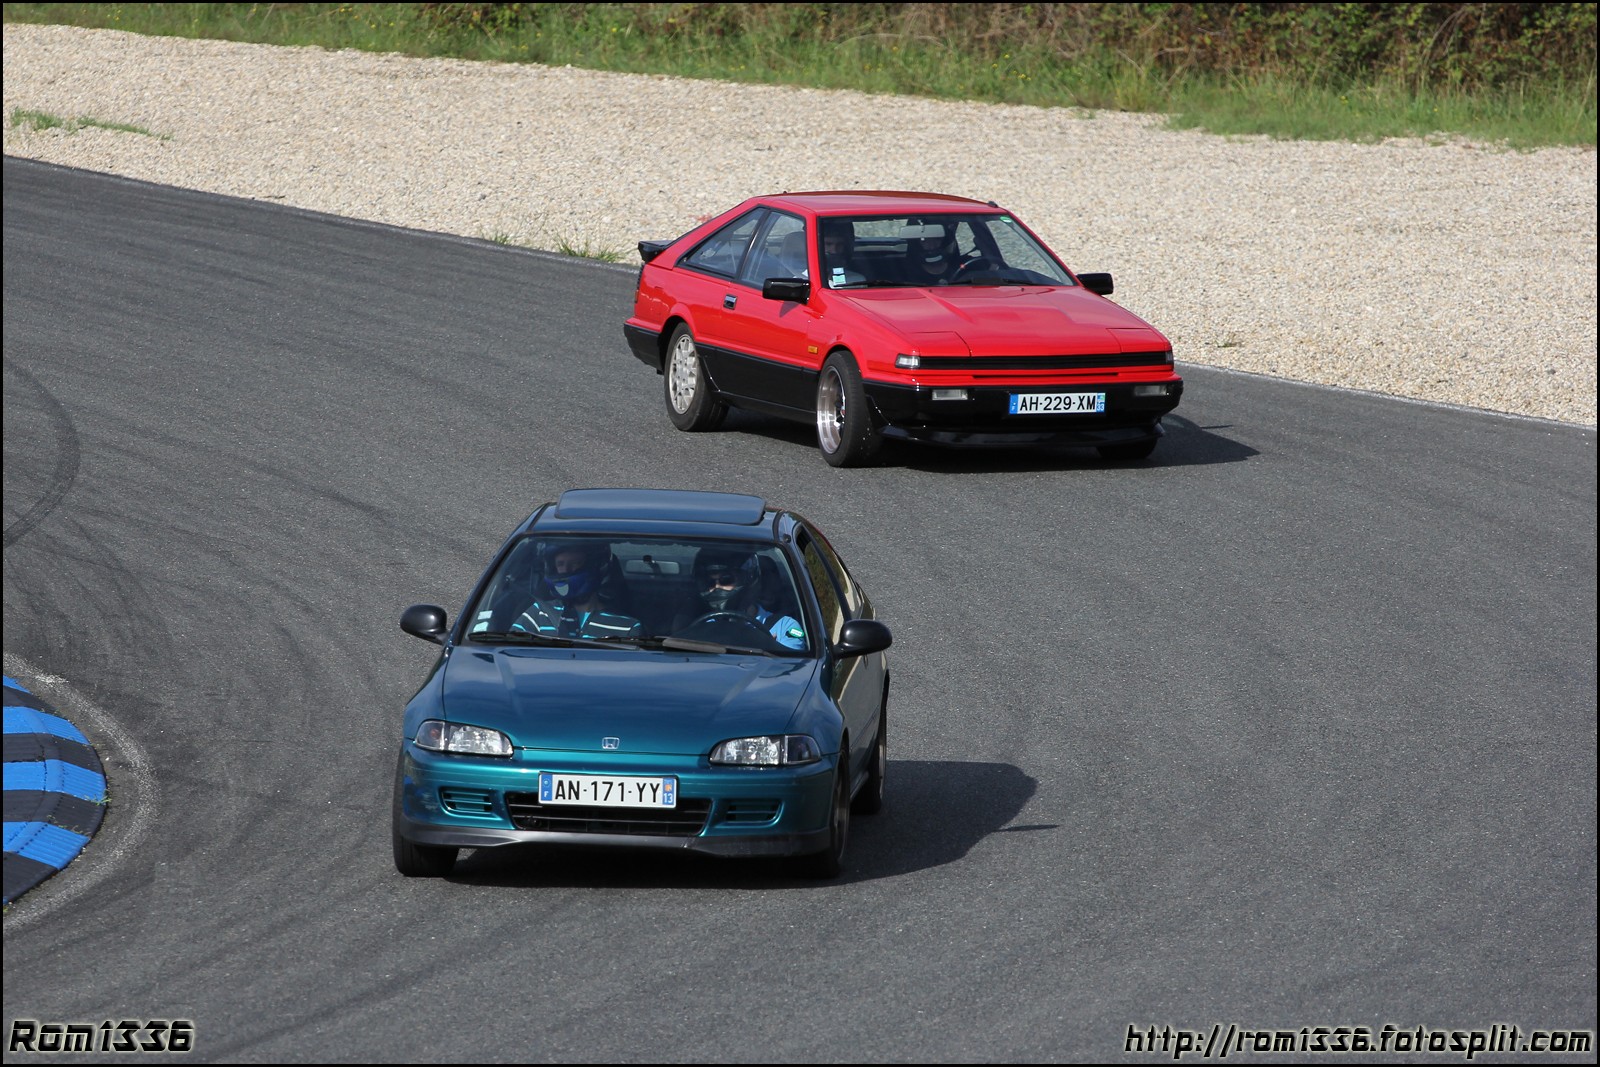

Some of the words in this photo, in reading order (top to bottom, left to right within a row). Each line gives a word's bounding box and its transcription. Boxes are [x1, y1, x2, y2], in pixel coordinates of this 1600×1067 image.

[1020, 395, 1096, 411] AH-229-XM
[555, 780, 660, 803] AN-171-YY
[663, 793, 673, 803] 13
